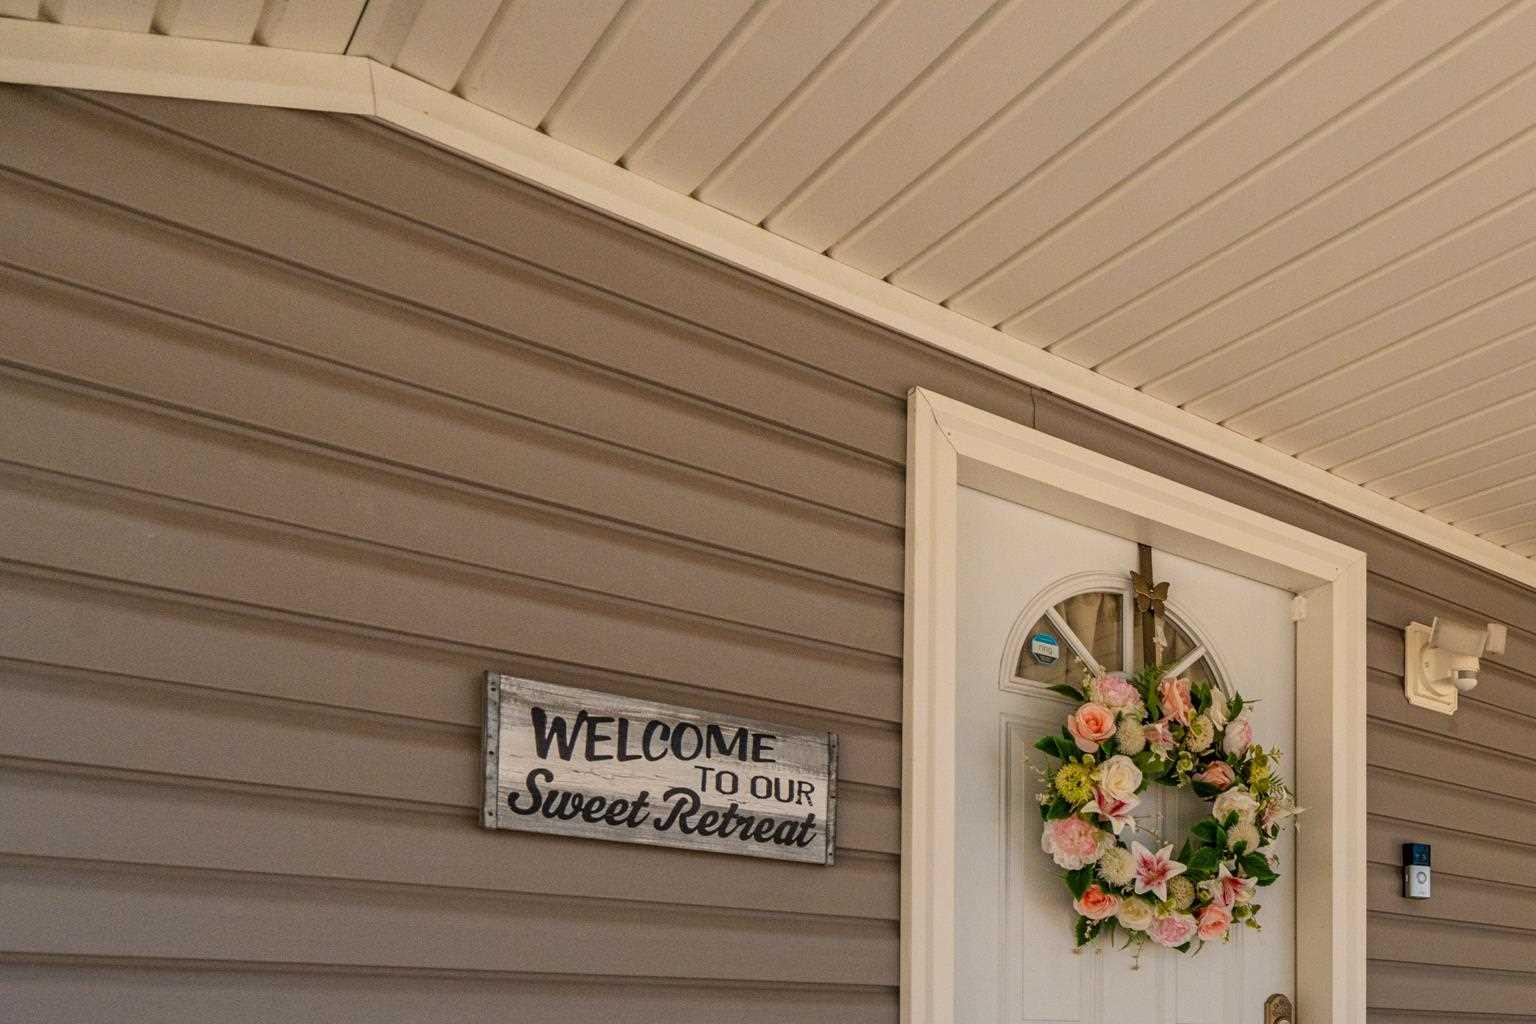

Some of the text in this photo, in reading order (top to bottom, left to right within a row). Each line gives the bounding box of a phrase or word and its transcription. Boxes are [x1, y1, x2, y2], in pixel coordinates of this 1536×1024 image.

[531, 706, 777, 763] WELCOME
[507, 768, 817, 848] Sweet Retreat
[694, 765, 816, 807] TO OUR
